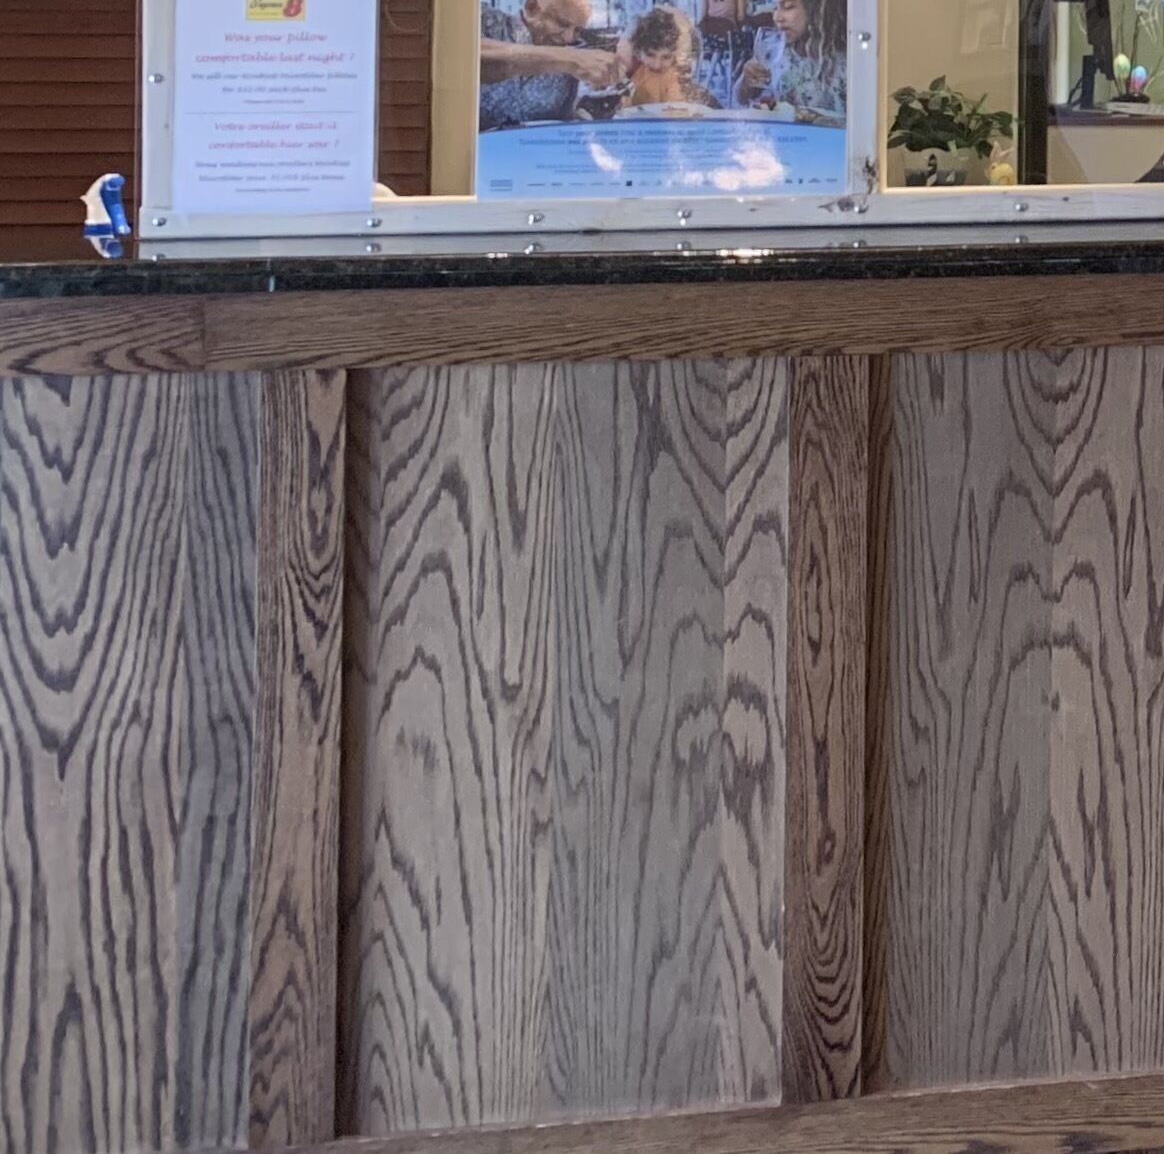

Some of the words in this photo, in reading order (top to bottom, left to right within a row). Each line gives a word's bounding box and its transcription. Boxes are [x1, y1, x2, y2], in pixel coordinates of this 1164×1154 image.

[224, 32, 250, 42] Was
[254, 33, 283, 44] your
[287, 31, 329, 44] pillow
[195, 52, 276, 65] comfortable
[279, 52, 305, 63] last
[308, 51, 345, 65] night
